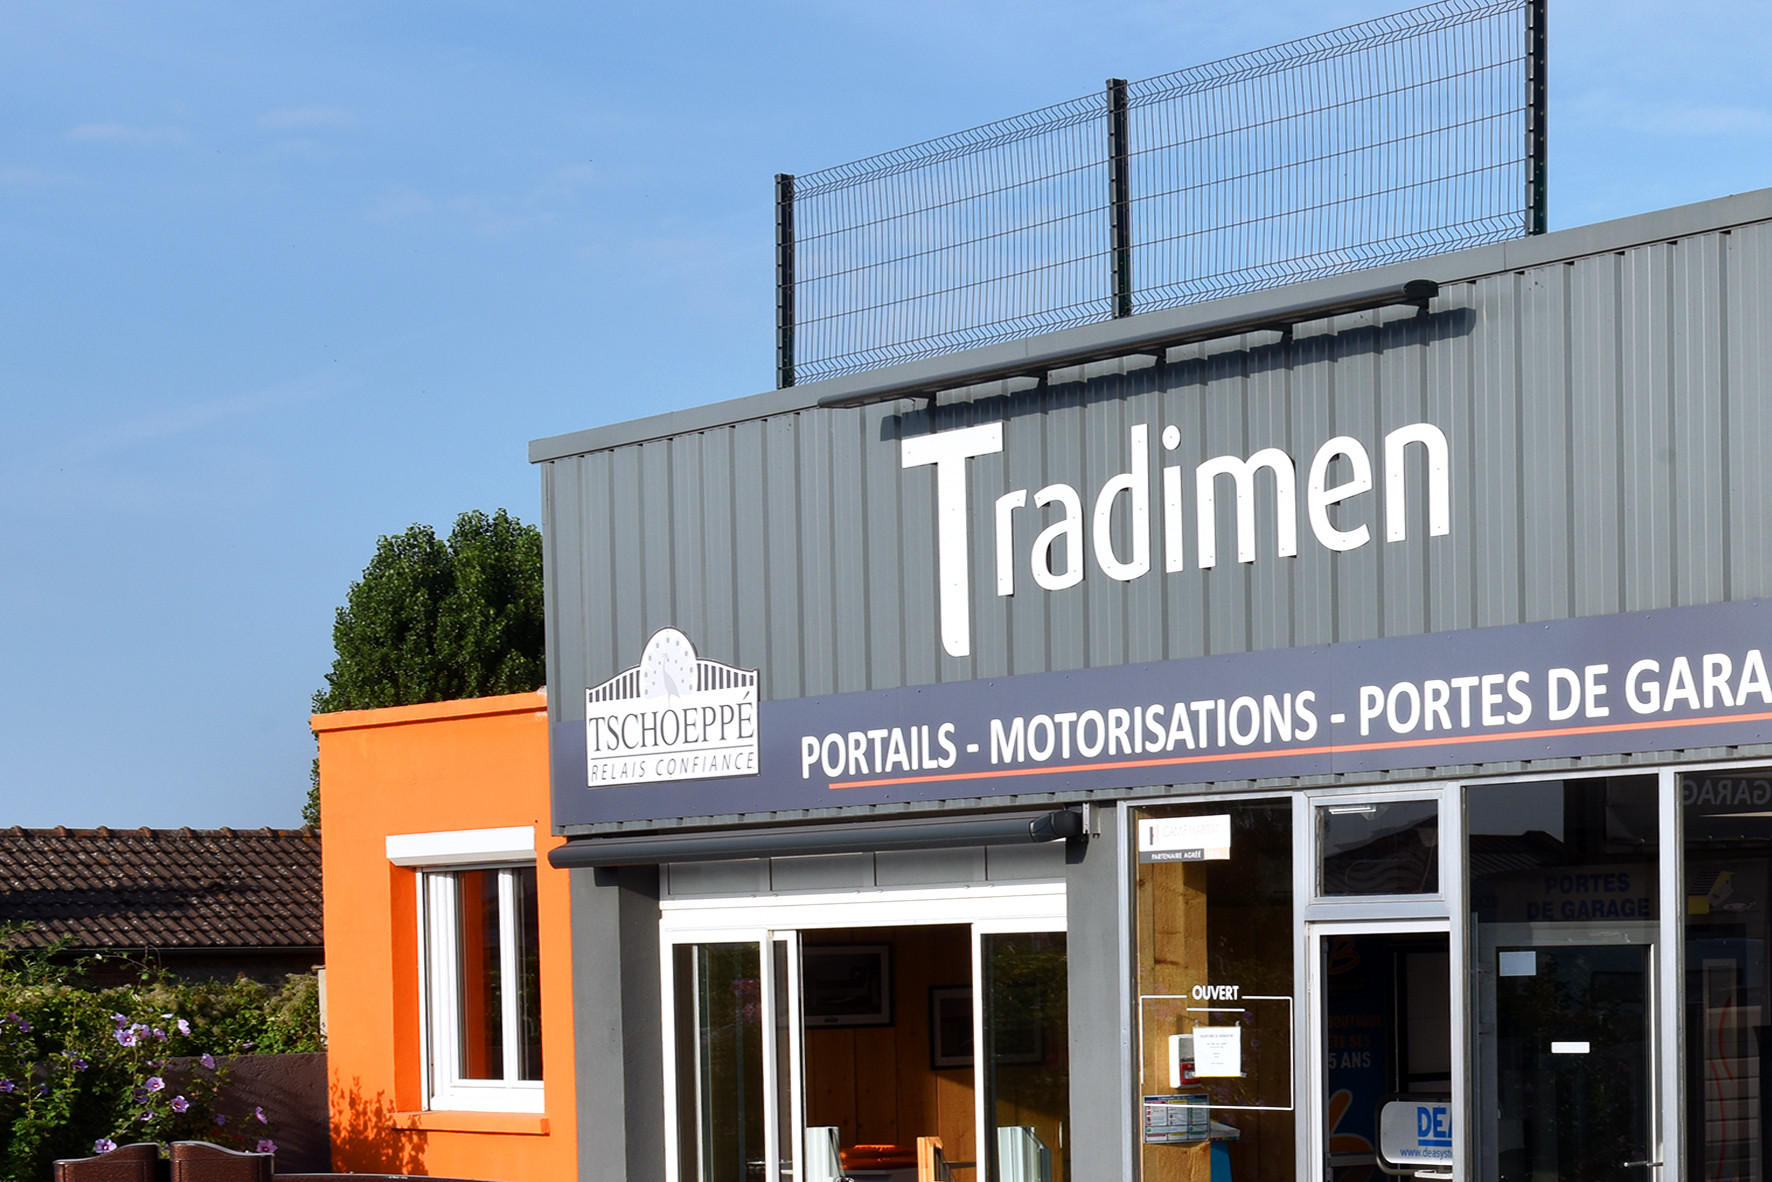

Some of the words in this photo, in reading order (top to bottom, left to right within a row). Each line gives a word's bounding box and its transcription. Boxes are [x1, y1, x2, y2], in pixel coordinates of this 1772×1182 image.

[901, 421, 1450, 657] Tradimen
[589, 690, 755, 752] TSCHOEPPÉ
[801, 722, 957, 780] PORTAILS
[989, 690, 1318, 764] MOTORISATIONS
[1359, 671, 1533, 736] PORTES
[1548, 663, 1609, 720] DE
[591, 760, 647, 782] RELAIS
[655, 751, 755, 776] CONFIANCE
[1545, 872, 1631, 895] PORTES
[1526, 901, 1555, 920] DE
[1561, 897, 1651, 920] GARAGE
[1192, 985, 1240, 1001] OUVERT
[1340, 1051, 1372, 1069] ANS
